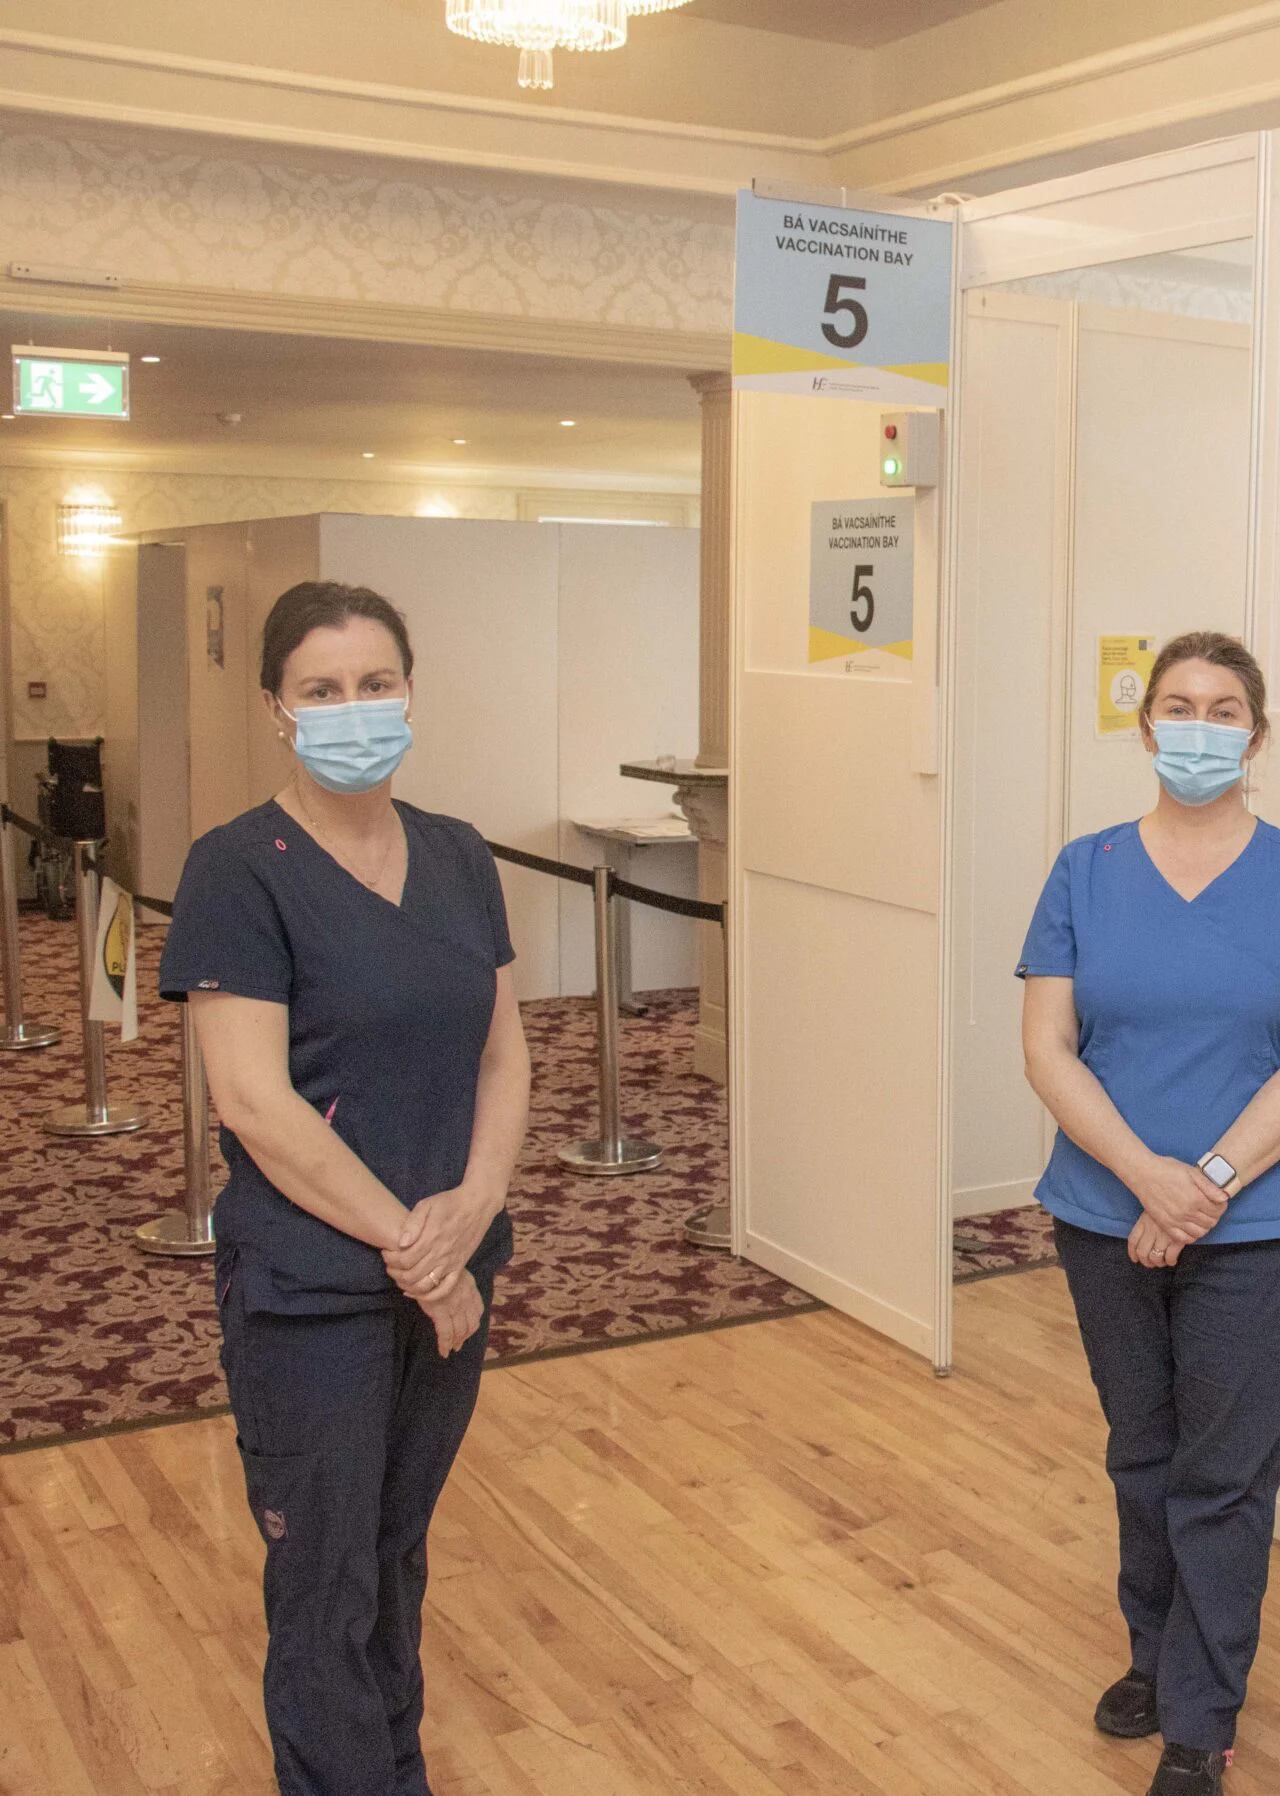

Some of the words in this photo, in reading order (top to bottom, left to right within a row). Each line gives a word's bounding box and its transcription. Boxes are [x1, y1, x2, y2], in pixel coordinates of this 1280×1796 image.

[783, 213, 804, 231] BÁ
[809, 218, 908, 245] VACSAÍNÍTHE
[776, 236, 879, 262] VACCINATION
[883, 250, 913, 266] BAY
[821, 273, 868, 349] 5
[832, 513, 843, 530] BÁ
[844, 512, 896, 530] VACSAÍNÍTHE
[828, 537, 881, 549] VACCINATION
[883, 536, 899, 548] BAY
[850, 564, 875, 633] 5
